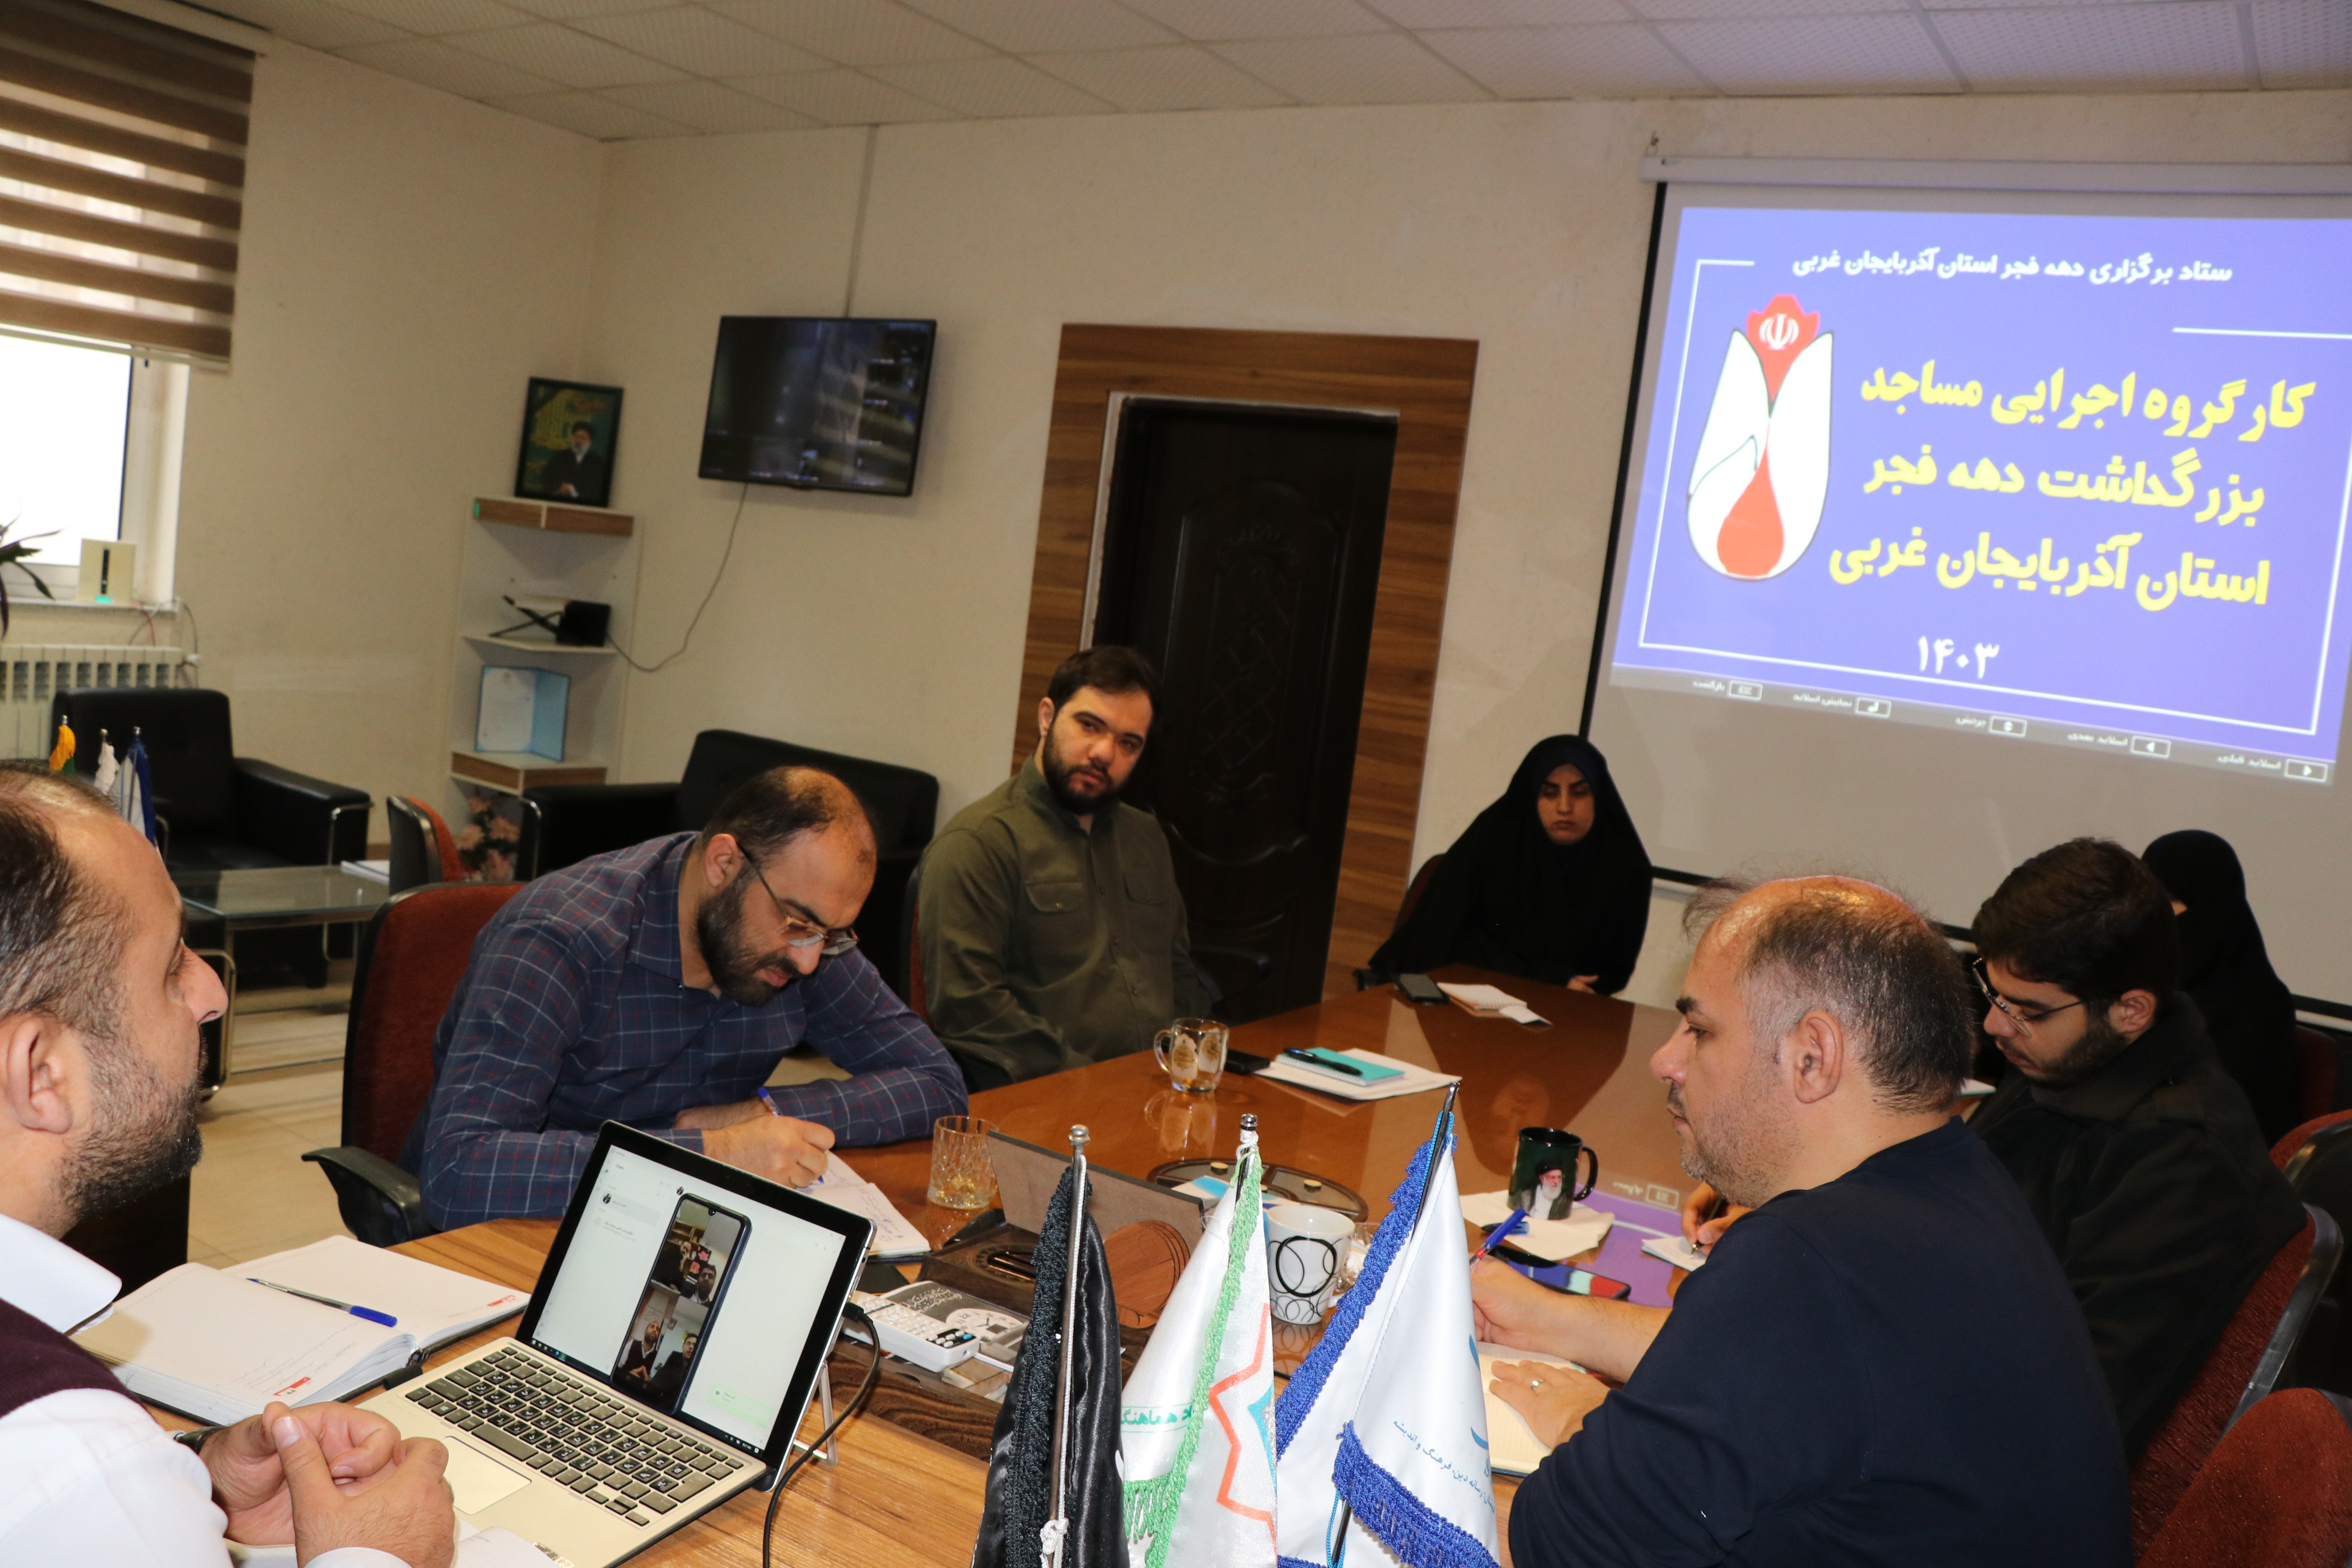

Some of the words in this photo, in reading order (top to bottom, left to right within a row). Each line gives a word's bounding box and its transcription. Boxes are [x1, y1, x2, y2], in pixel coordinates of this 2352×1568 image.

[1793, 250, 1840, 276] غربی
[1844, 247, 1940, 275] آذربایجان
[1937, 253, 1997, 279] استان
[2000, 255, 2039, 279] فجر
[2044, 260, 2084, 277] دهه
[2089, 252, 2173, 284] برگزاری
[2178, 261, 2232, 281] ستاد
[1861, 360, 1983, 415] مساجد
[1991, 368, 2136, 429] اجرایی
[1864, 445, 1937, 495] فجر
[1948, 457, 2025, 493] دهه
[2038, 448, 2265, 527] بزرگداشت
[1829, 527, 1927, 584] غربی
[1936, 532, 2143, 597] آذربایجان
[2136, 552, 2270, 612] استان
[1918, 636, 2000, 679] ۱۴۰۳
[1394, 1421, 1417, 1442] اندیشه
[1423, 1448, 1452, 1469] فرهنگ
[1469, 1480, 1483, 1497] رسانه
